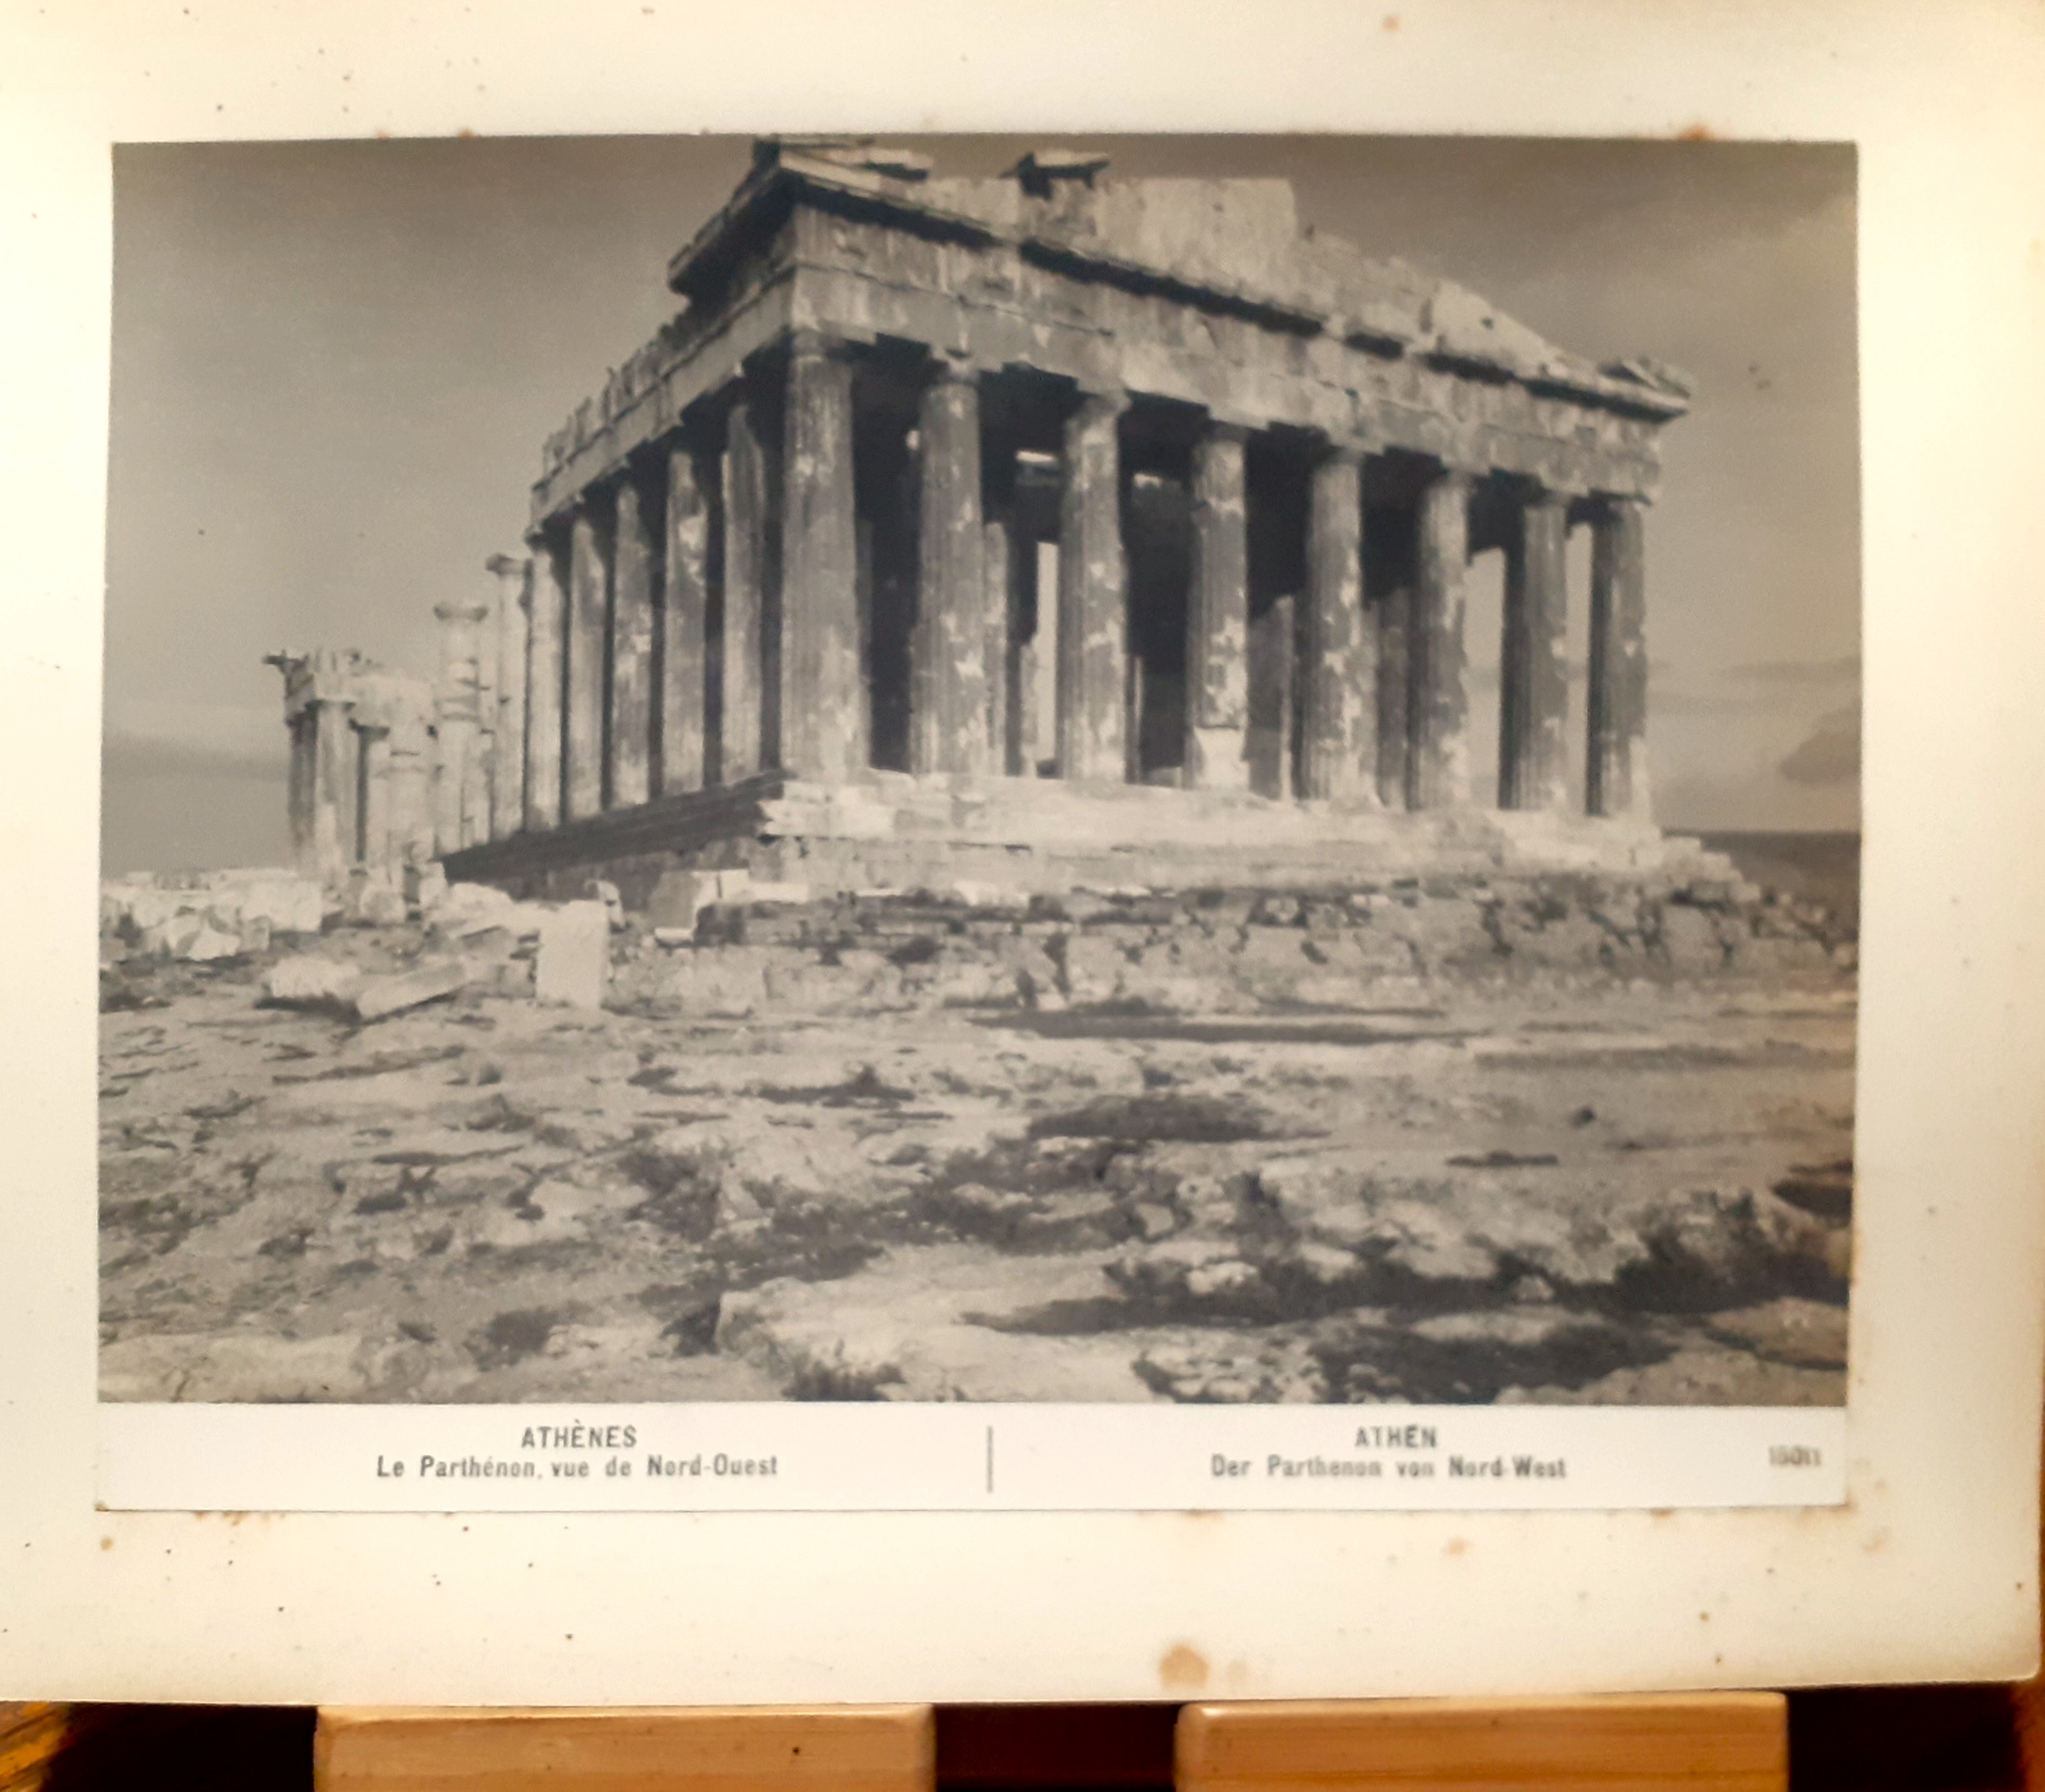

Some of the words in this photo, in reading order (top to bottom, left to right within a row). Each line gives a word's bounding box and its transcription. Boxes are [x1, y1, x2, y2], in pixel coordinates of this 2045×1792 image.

[520, 1418, 637, 1449] ATHÈNES
[1354, 1424, 1438, 1449] ATHEN
[376, 1455, 404, 1478] Le
[550, 1461, 589, 1478] vue
[605, 1455, 631, 1478] de
[647, 1453, 777, 1477] Nord-Ouest
[1210, 1453, 1251, 1478] Der
[1266, 1453, 1382, 1478] Parthenon
[1396, 1460, 1435, 1478] von
